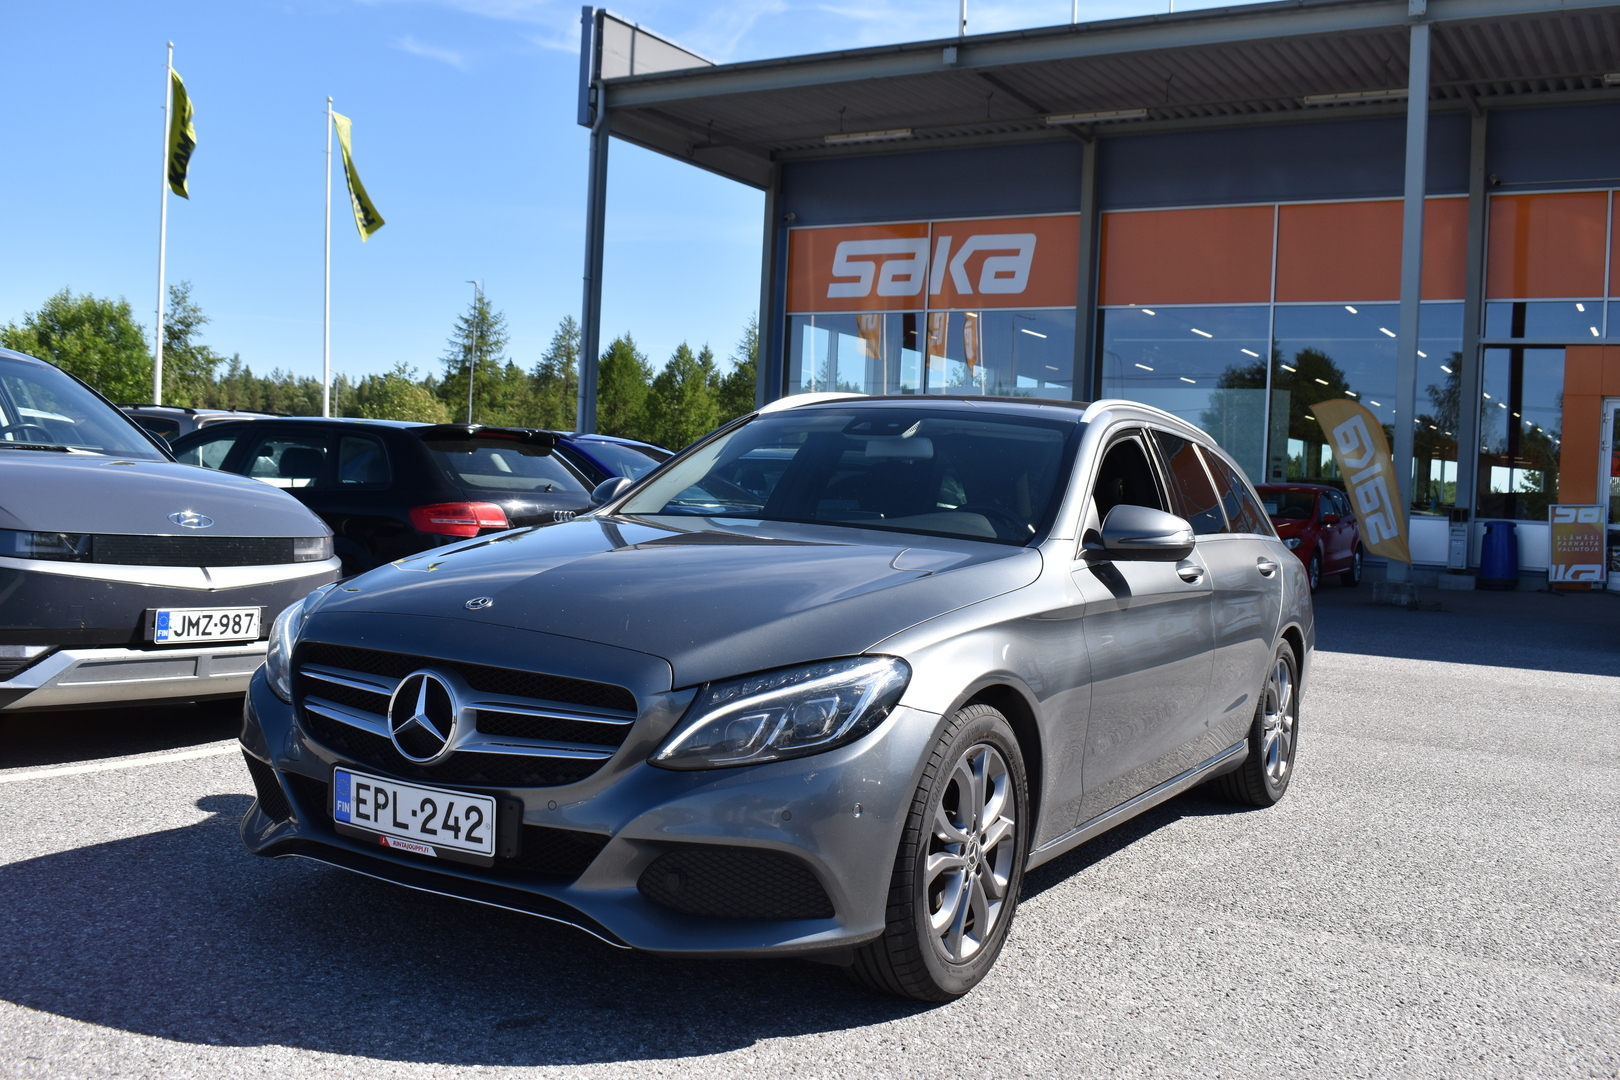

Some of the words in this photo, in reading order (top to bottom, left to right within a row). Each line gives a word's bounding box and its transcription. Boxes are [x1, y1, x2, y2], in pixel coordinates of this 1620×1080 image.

[157, 629, 169, 637] FIN
[173, 613, 255, 637] JMZ-987
[337, 800, 350, 814] FIN
[355, 782, 484, 844] EPL-242
